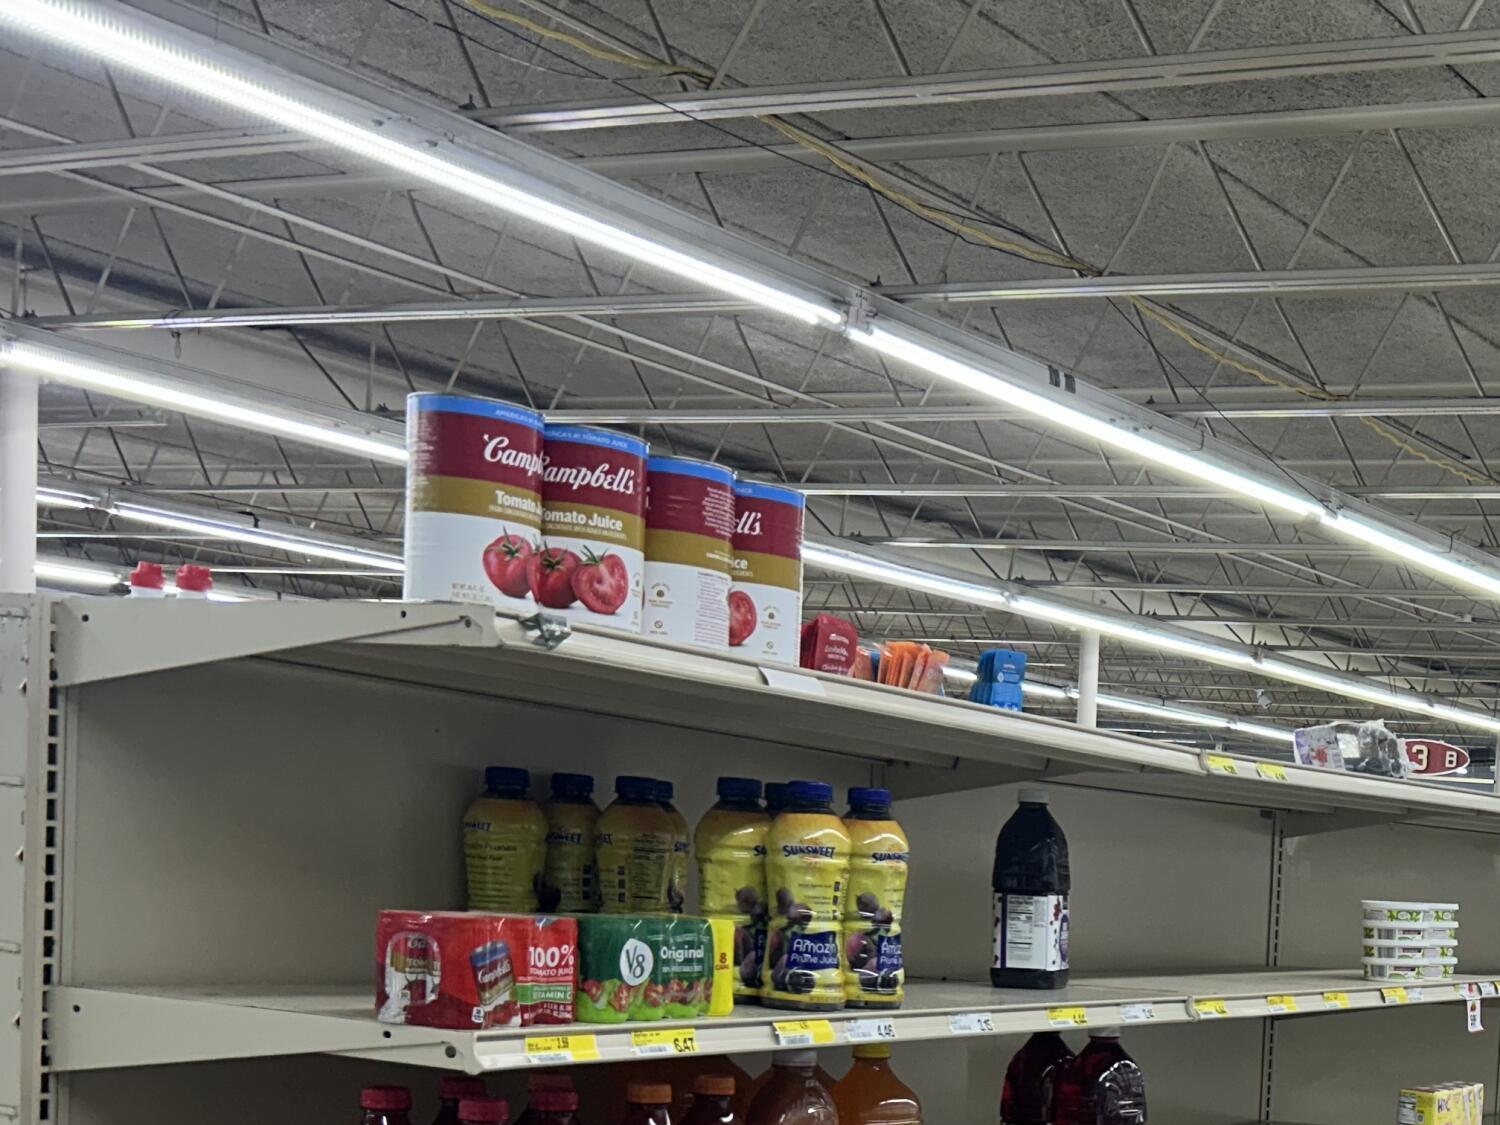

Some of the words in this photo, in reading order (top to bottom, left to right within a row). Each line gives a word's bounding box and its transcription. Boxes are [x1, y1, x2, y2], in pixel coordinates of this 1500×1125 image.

[588, 513, 624, 531] Juice
[1412, 745, 1429, 770] 3
[1445, 752, 1457, 768] B
[783, 845, 836, 858] SUNSWEET
[529, 945, 575, 967] 100%
[626, 946, 646, 978] V8
[660, 945, 704, 962] Original
[719, 952, 727, 964] 8
